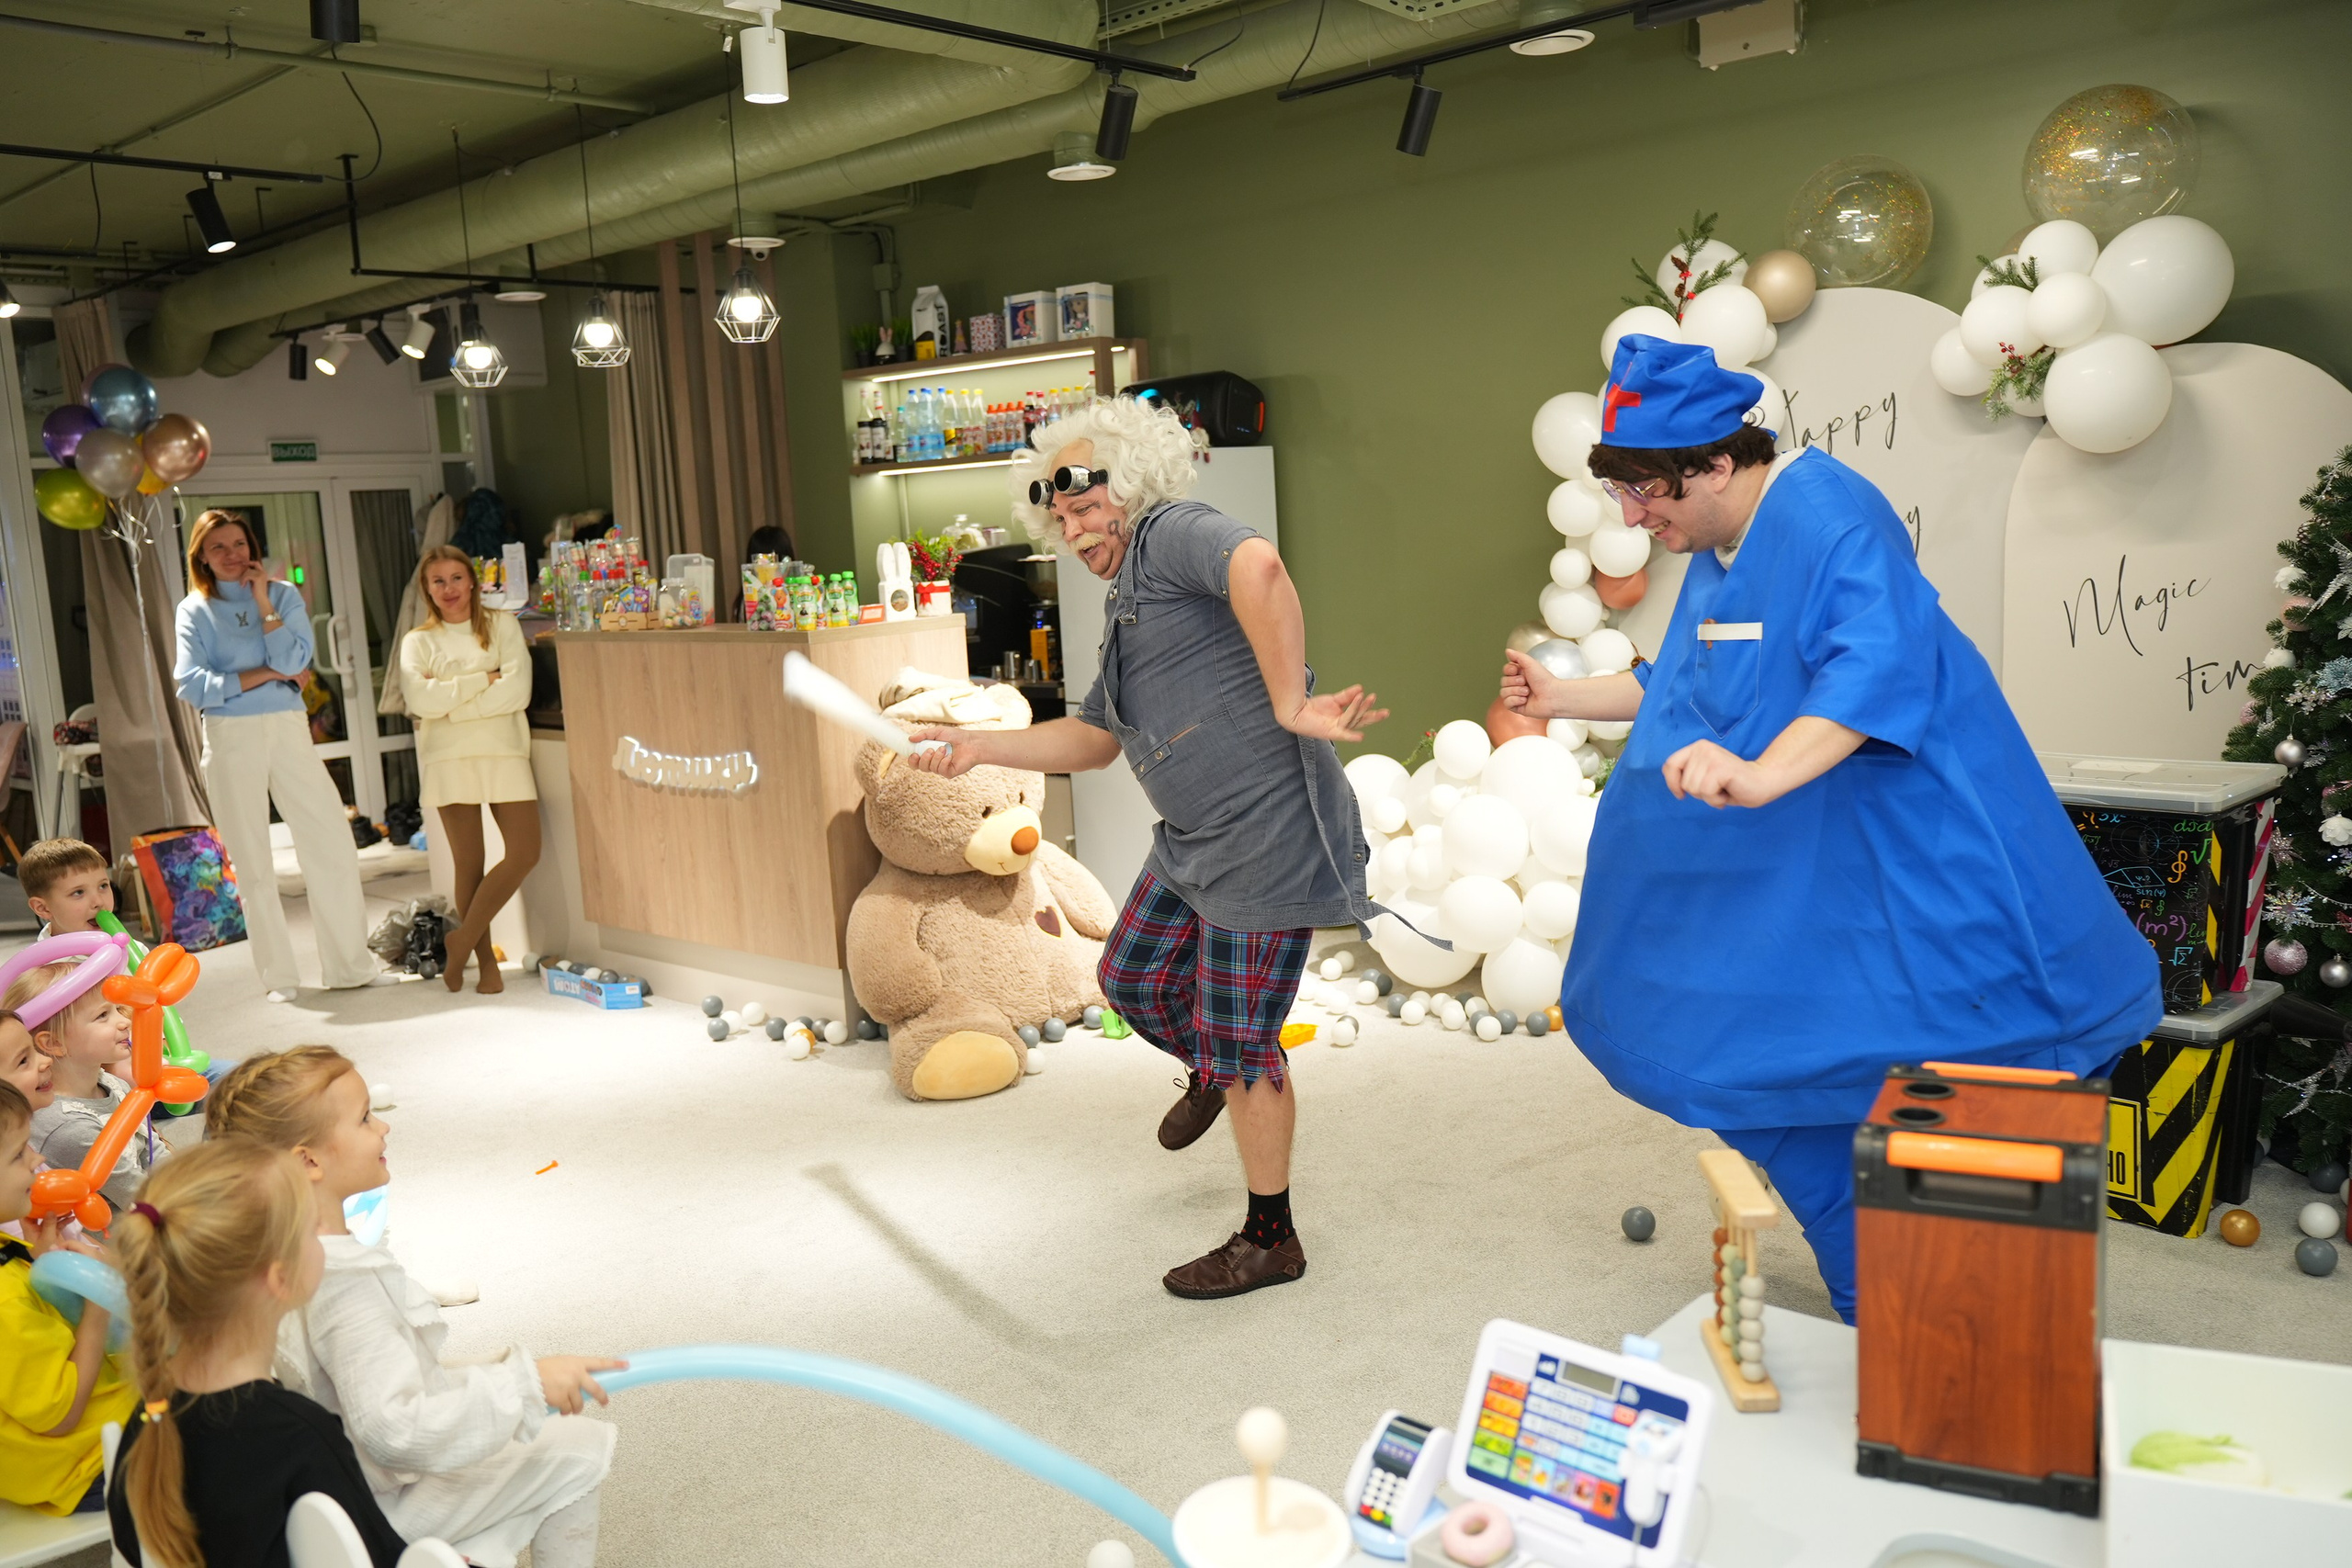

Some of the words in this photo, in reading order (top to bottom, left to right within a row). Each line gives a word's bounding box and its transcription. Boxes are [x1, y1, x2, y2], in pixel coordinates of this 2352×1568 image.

[272, 446, 315, 458] ВЫХОД
[2064, 554, 2211, 657] Magic
[2176, 657, 2266, 712] tim
